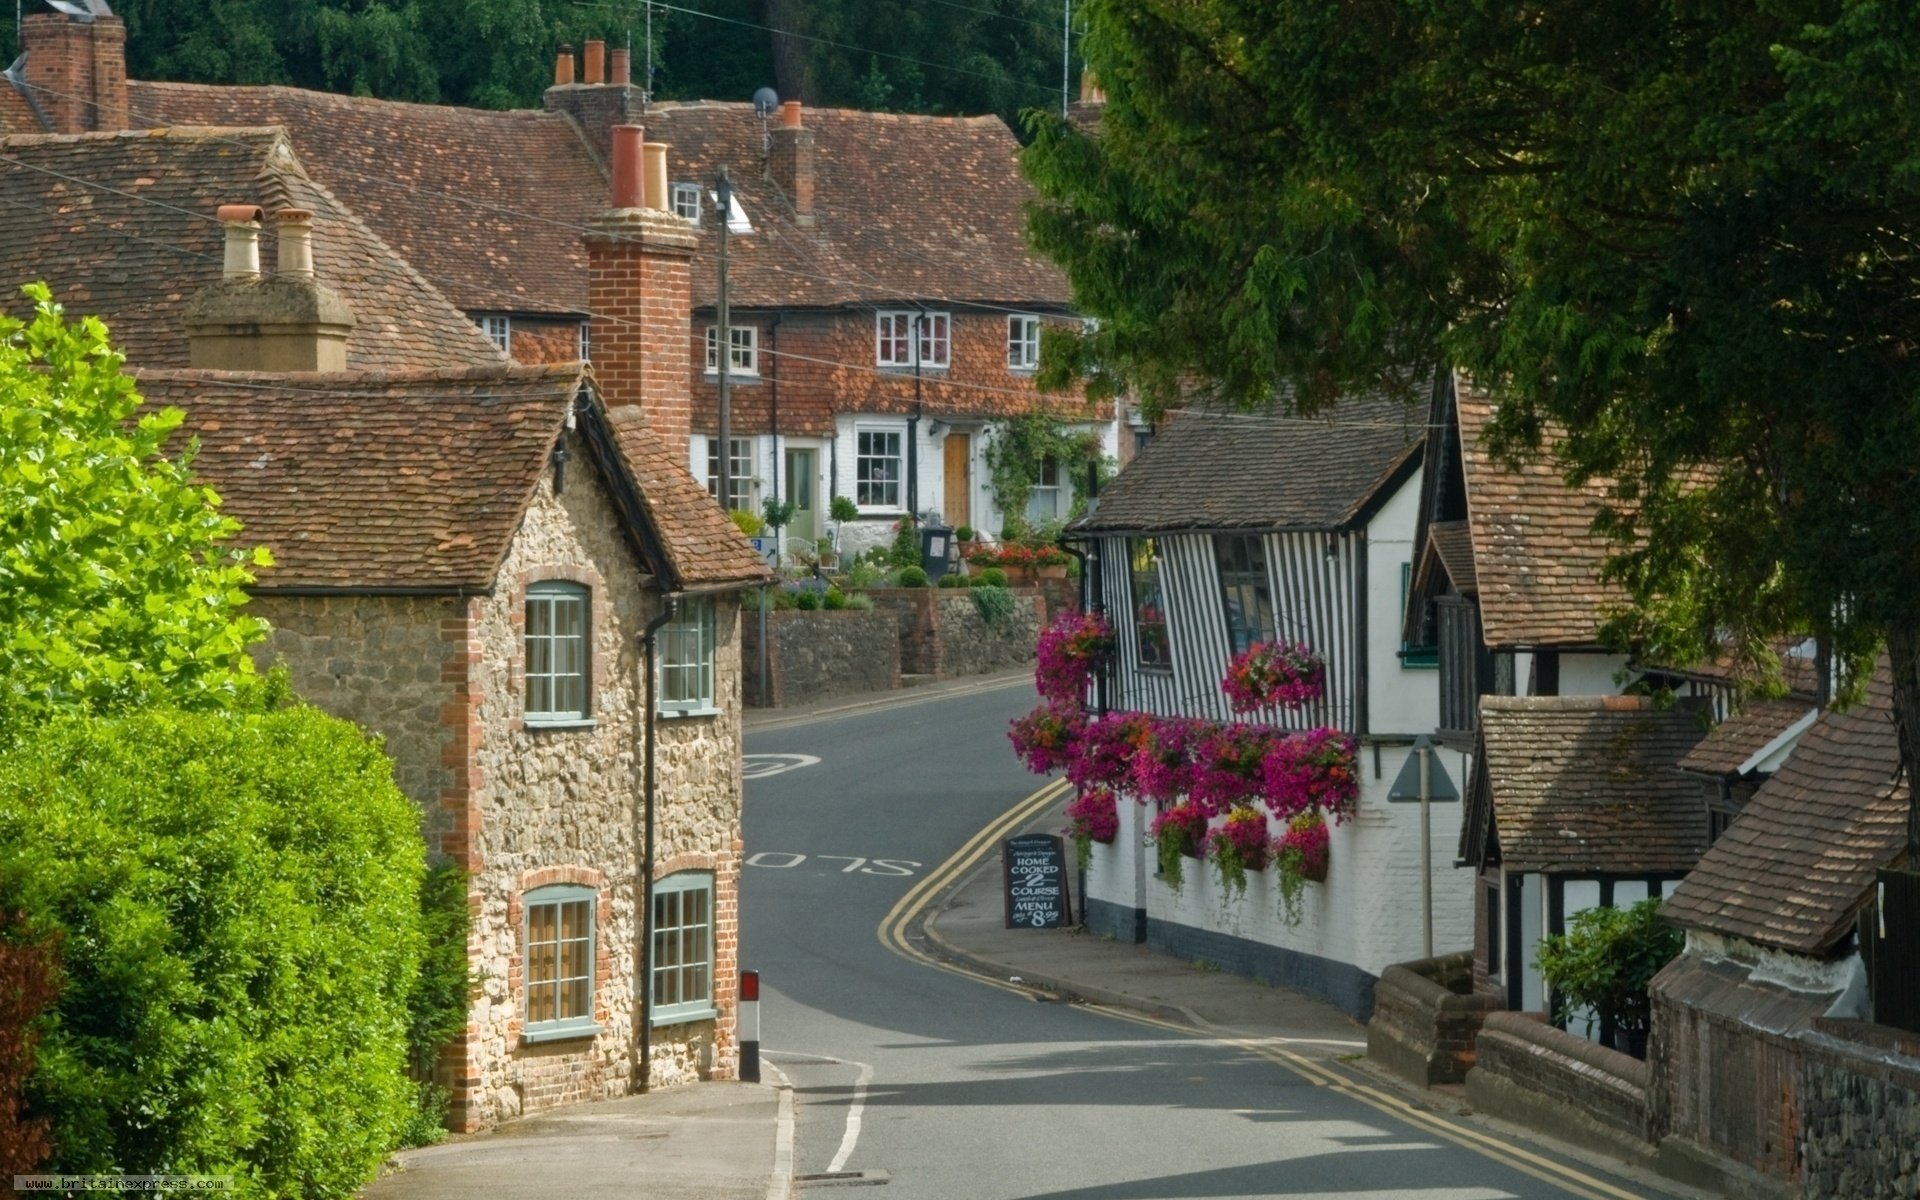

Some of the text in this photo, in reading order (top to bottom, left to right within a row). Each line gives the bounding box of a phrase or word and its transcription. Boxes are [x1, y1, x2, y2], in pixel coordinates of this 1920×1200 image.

[745, 852, 922, 876] SLO
[1017, 858, 1050, 866] HOME
[1011, 865, 1059, 874] COOKED
[1025, 873, 1044, 887] 2
[1011, 886, 1060, 896] COURSE
[1014, 902, 1053, 911] MENU
